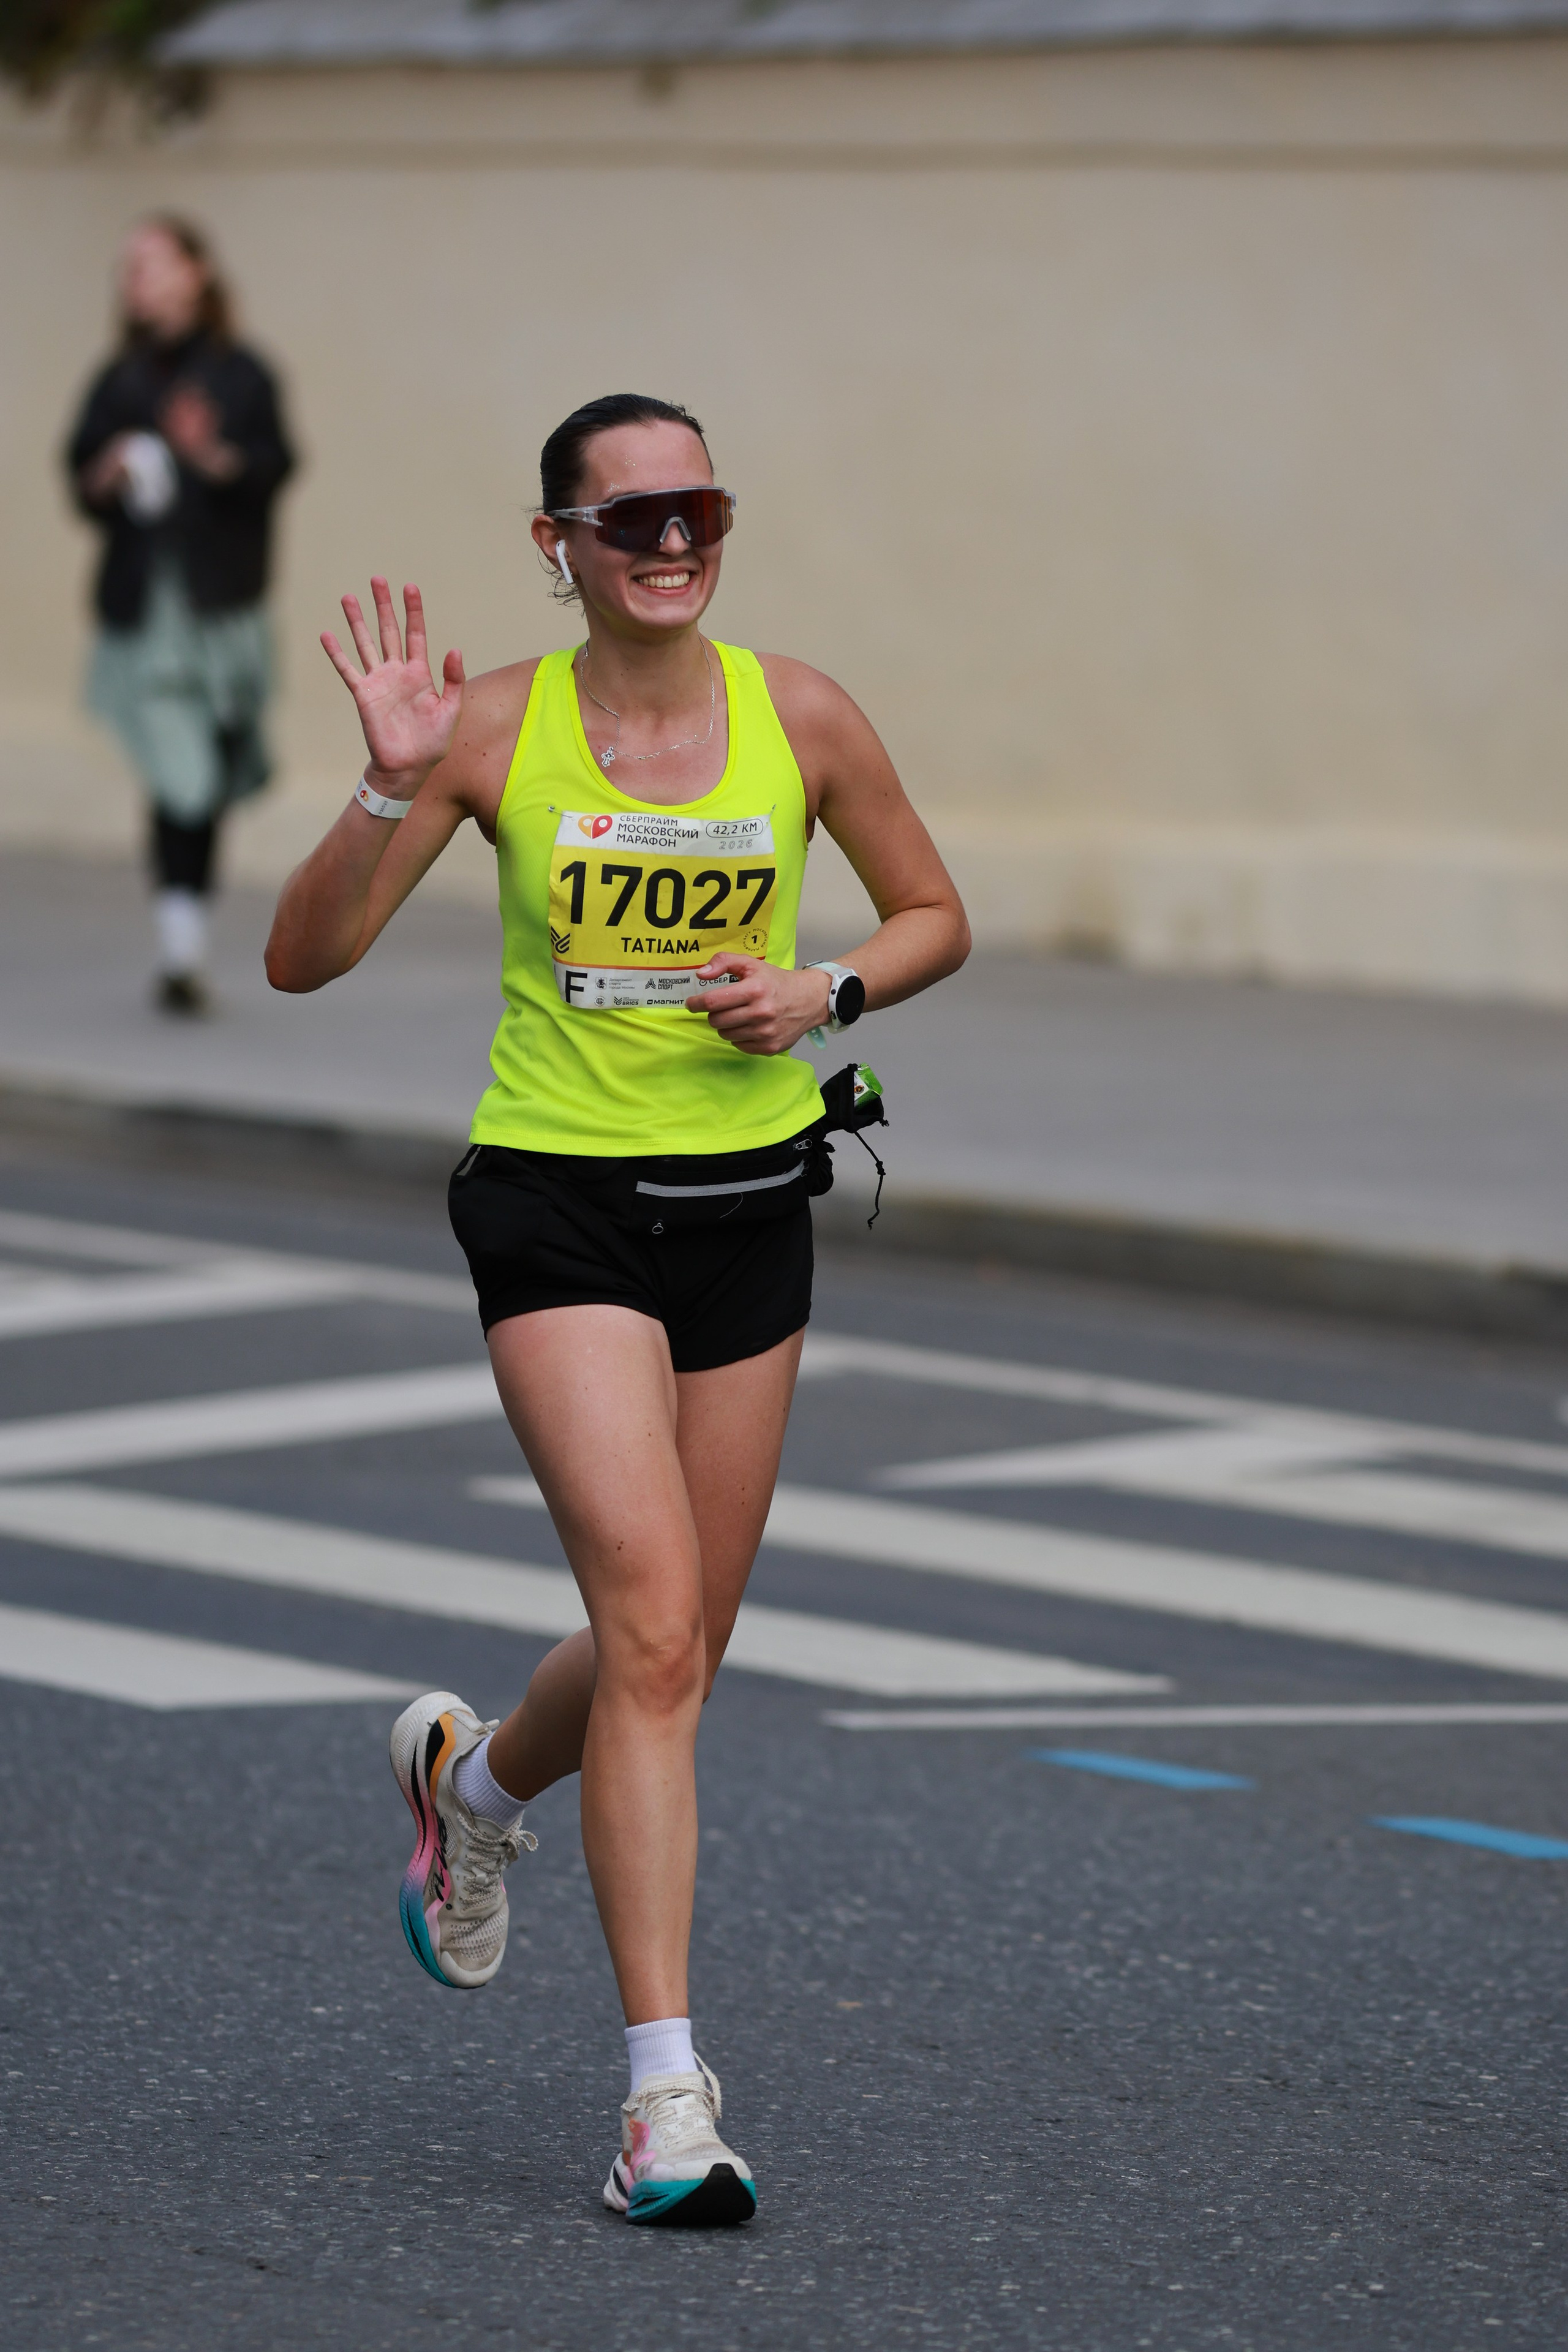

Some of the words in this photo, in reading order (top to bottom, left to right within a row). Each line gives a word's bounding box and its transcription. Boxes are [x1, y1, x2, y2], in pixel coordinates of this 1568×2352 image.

[620, 815, 678, 826] СБЕРПРАЙМ
[617, 823, 699, 839] МОСКОВСКИЙ
[712, 825, 737, 835] 42,2
[741, 823, 758, 833] КМ
[616, 834, 677, 848] МАРАФОН
[718, 839, 753, 850] 2026
[560, 861, 775, 930] 17027
[621, 937, 700, 954] TATIANA
[751, 935, 758, 944] 1
[565, 970, 588, 1004] F
